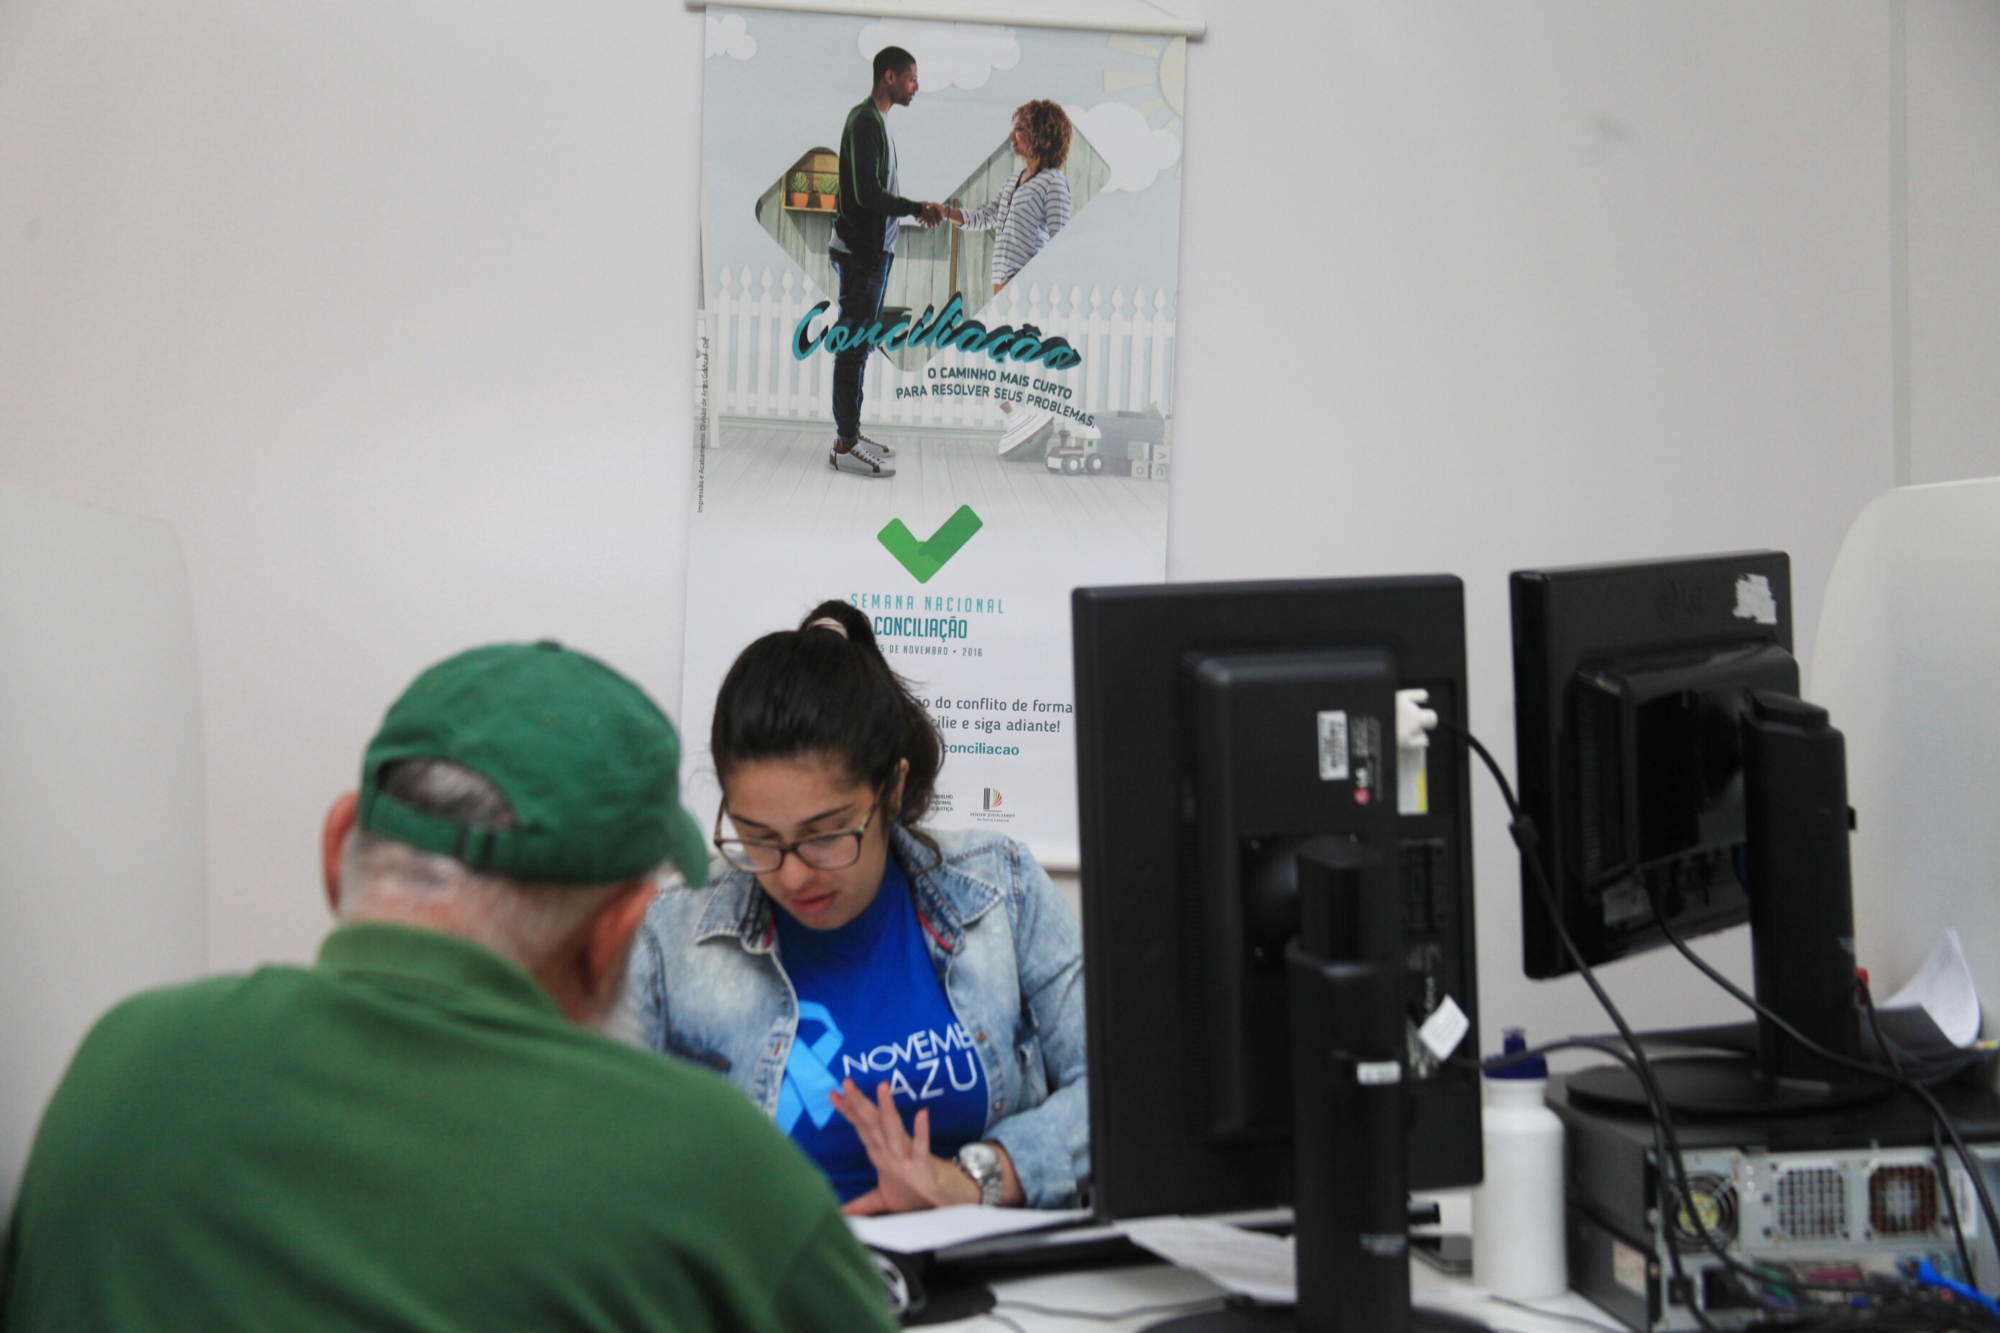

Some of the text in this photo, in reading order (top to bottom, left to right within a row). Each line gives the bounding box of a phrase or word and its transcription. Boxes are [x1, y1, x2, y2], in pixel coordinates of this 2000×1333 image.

[792, 291, 1082, 370] Conciliação
[927, 367, 1072, 400] O CAMINHO MAIS CURTO
[896, 384, 1095, 428] PARA RESOLVER SEUS PROBLEMAS.
[851, 593, 1004, 614] SEMANA NACIONAL
[874, 616, 968, 642] CONCILIAÇÃO
[889, 645, 899, 653] DE
[903, 645, 948, 655] NOVEMBRO
[962, 648, 982, 657] 2016
[935, 696, 951, 709] do
[956, 697, 1007, 711] conflito
[1012, 699, 1028, 712] de
[1032, 699, 1073, 713] forma
[962, 719, 969, 729] e
[974, 717, 1001, 734] siga
[1006, 719, 1061, 733] adiante!
[842, 1022, 975, 1077] NOVEMB
[889, 1050, 979, 1101] AZU
